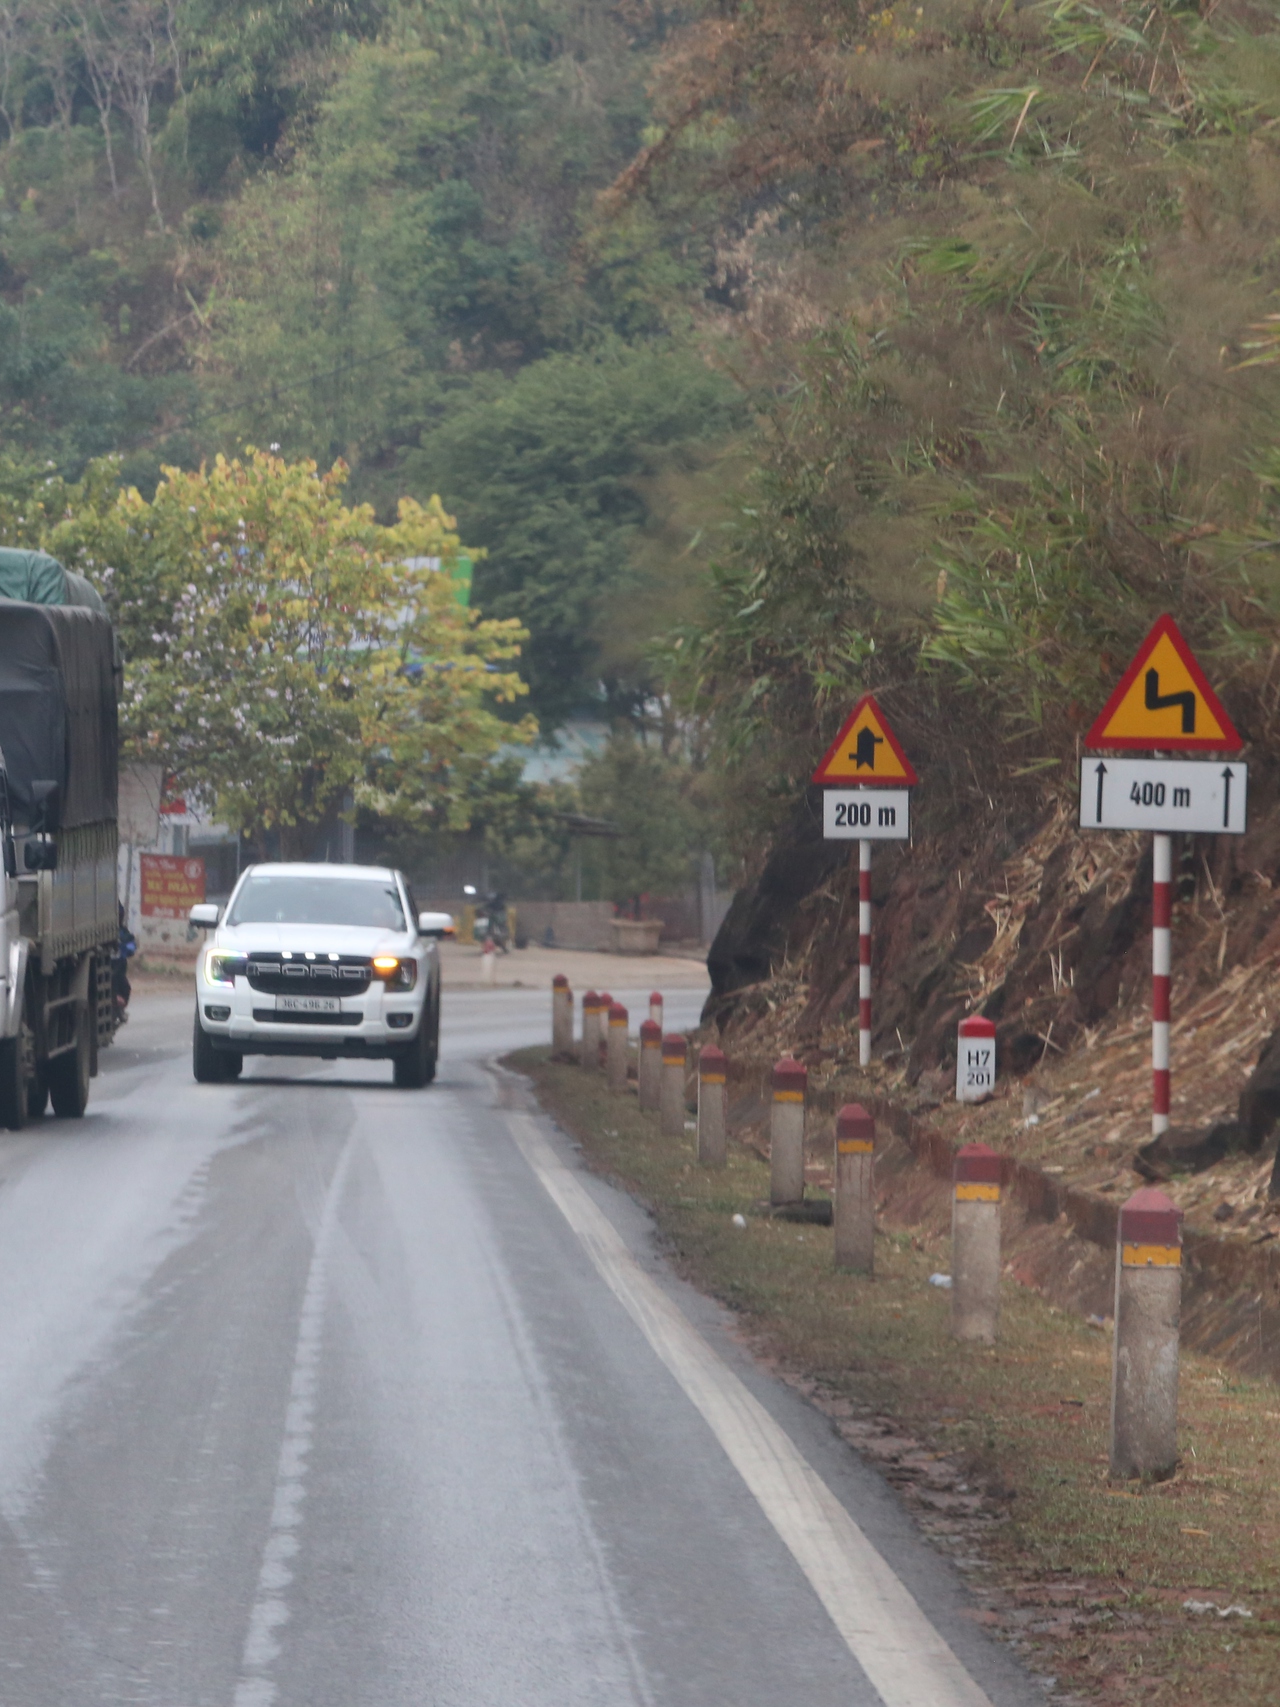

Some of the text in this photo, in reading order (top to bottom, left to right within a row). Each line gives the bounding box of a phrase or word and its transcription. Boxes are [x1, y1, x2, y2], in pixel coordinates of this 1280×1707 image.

[1129, 781, 1191, 807] 400 m
[835, 802, 896, 826] 200 m
[248, 962, 371, 978] FORD
[968, 1050, 990, 1066] H7
[967, 1072, 990, 1086] 201
